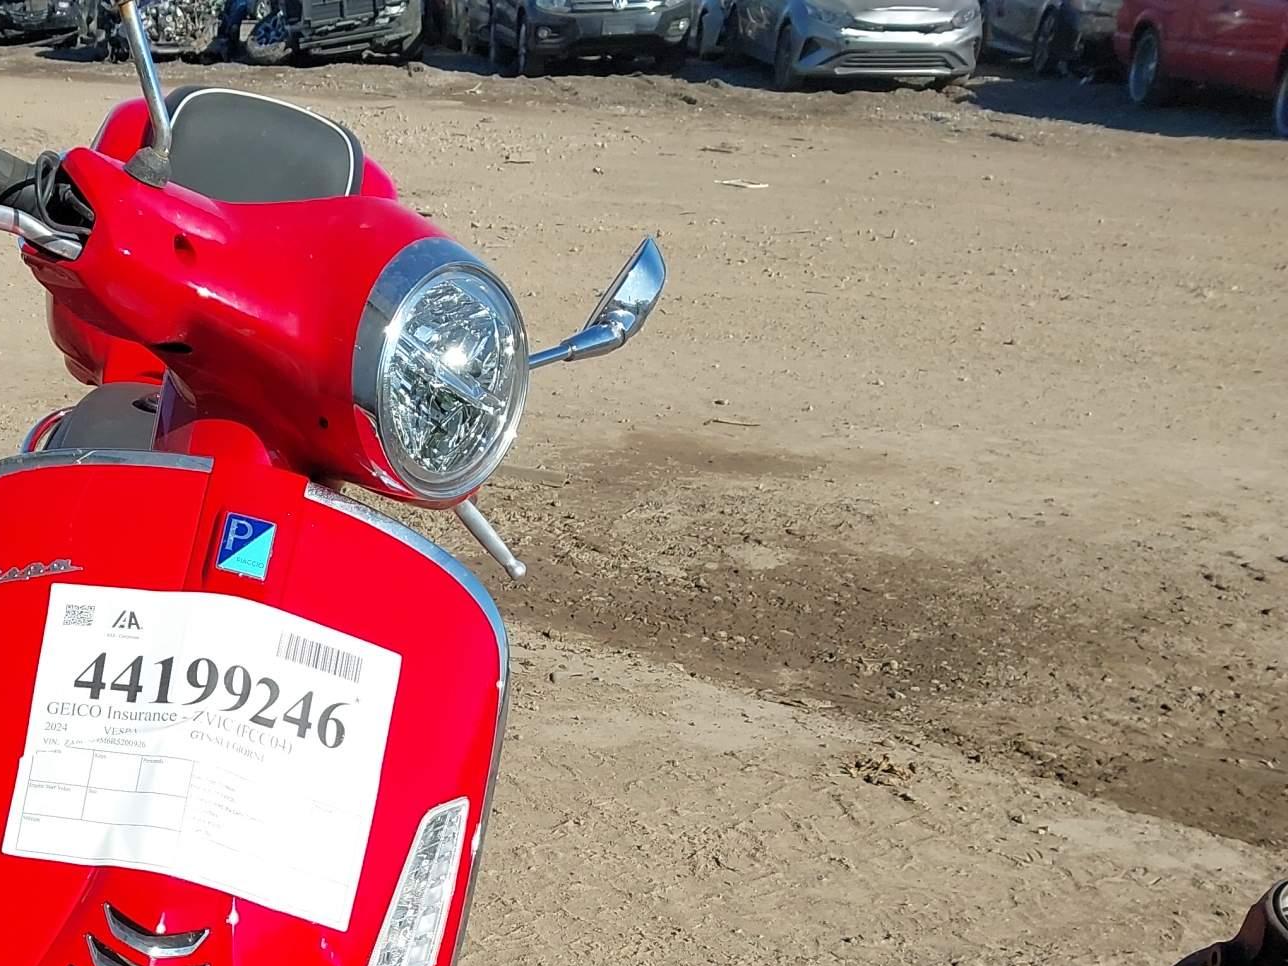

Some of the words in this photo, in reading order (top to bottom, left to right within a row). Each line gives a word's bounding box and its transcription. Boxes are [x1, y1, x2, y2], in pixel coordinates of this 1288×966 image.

[224, 517, 254, 551] P
[46, 701, 103, 718] GEICO
[107, 705, 179, 723] Insurance
[73, 651, 352, 749] 44199246
[43, 721, 69, 733] 2024
